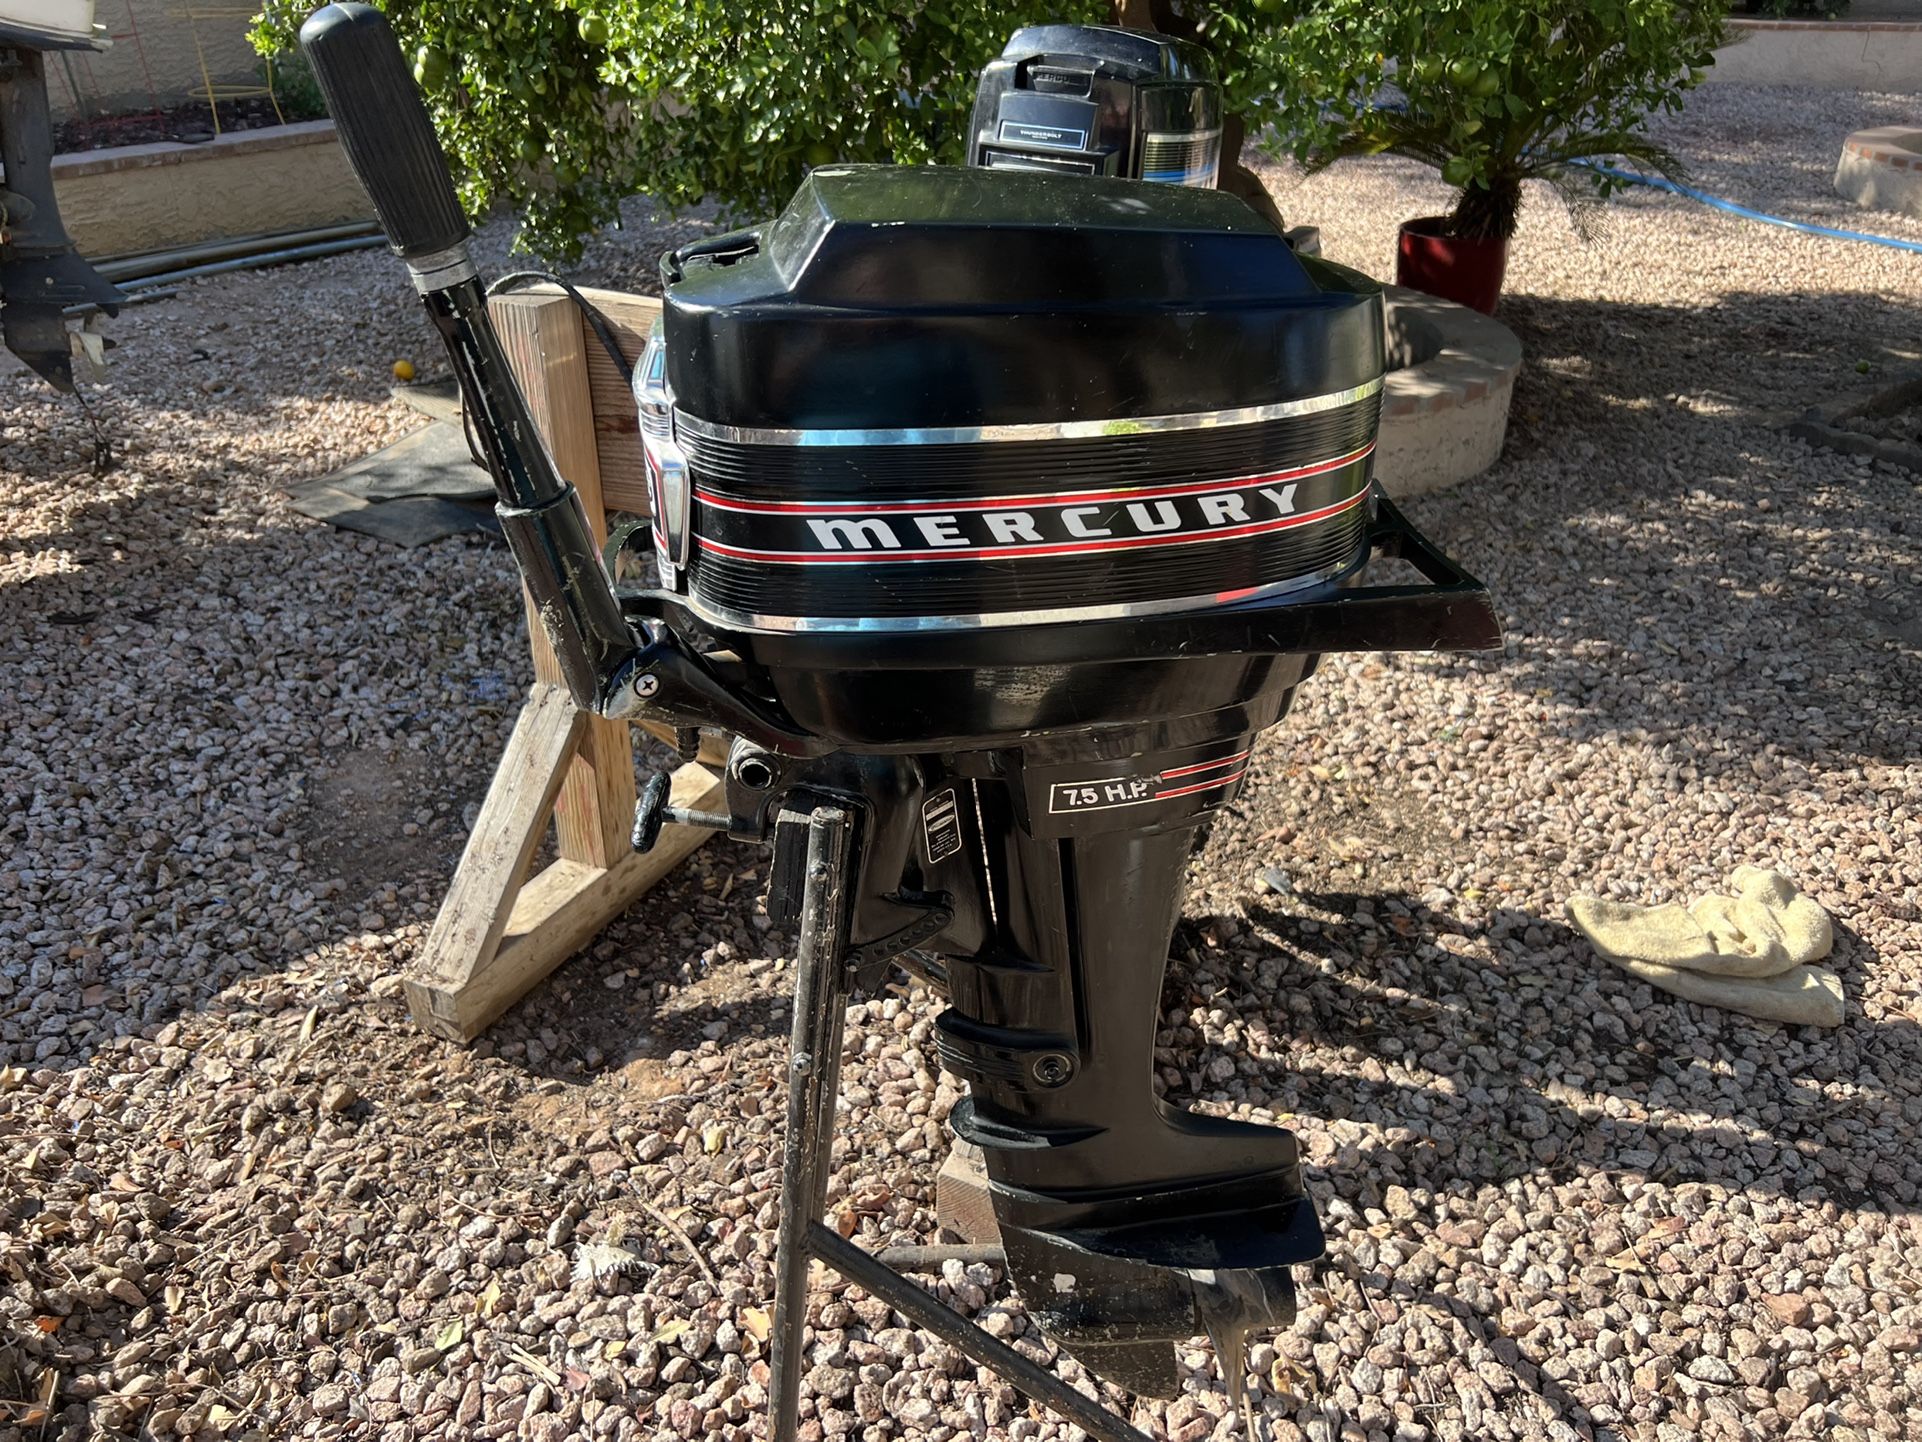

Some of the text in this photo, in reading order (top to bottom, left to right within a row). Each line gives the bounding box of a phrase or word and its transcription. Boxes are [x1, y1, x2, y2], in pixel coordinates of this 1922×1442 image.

[805, 483, 1299, 549] MERCURY
[1062, 782, 1147, 806] 7.5 H.P.
